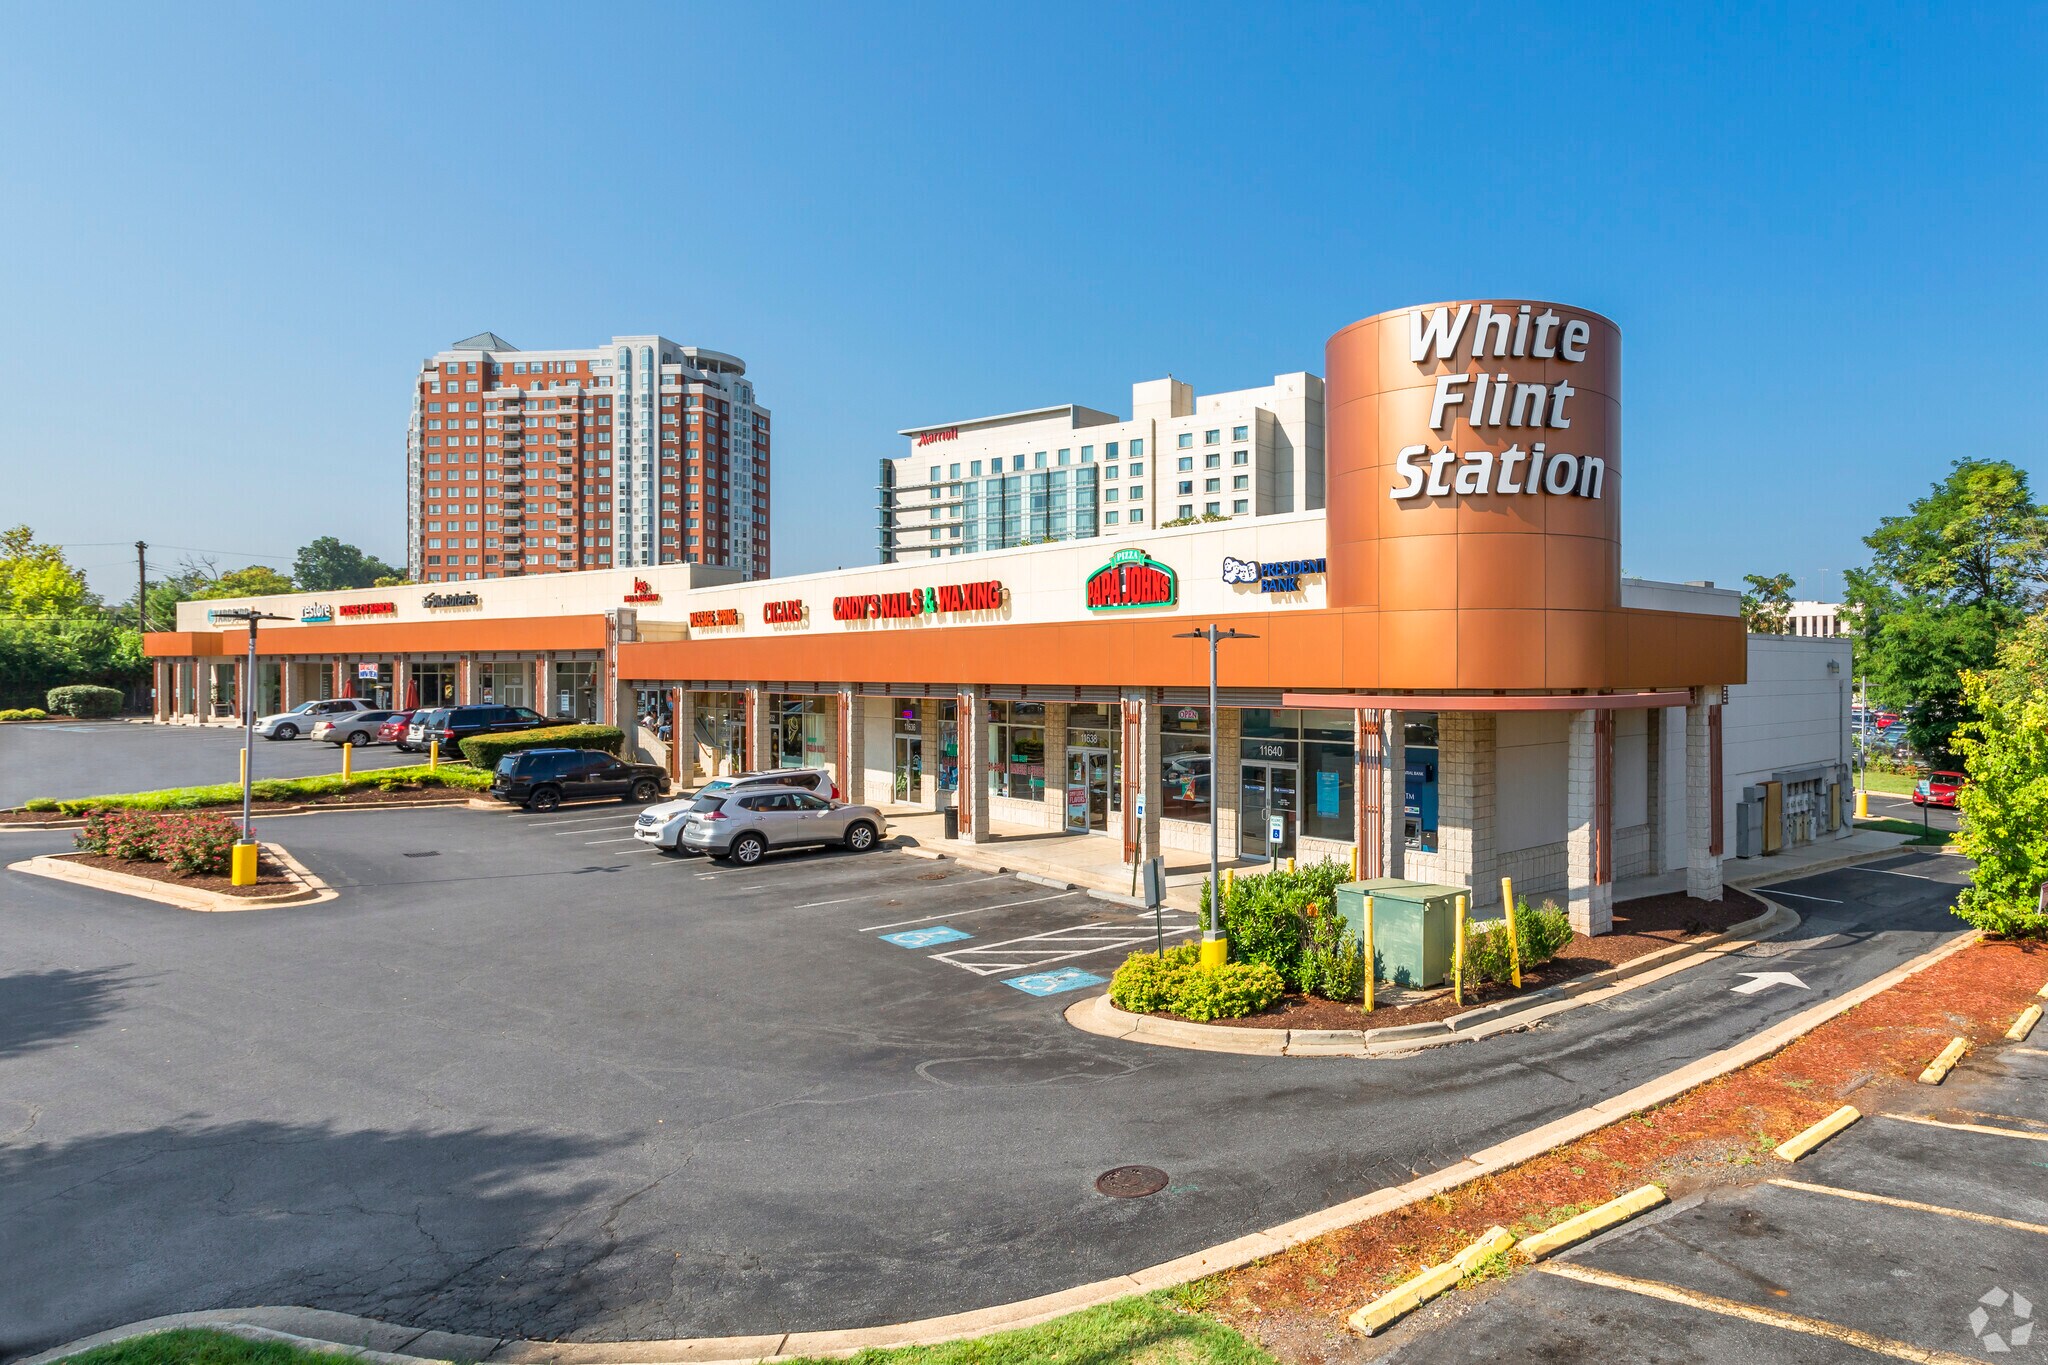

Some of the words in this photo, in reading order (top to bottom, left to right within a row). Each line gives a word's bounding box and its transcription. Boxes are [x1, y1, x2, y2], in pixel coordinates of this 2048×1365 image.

[1409, 304, 1590, 362] White
[1429, 374, 1575, 429] Flint
[917, 427, 958, 447] Marriott
[1389, 443, 1605, 500] Station
[1117, 551, 1138, 561] PIZZA
[1261, 558, 1326, 577] PRESIDENT
[1088, 568, 1121, 606] PAPA
[1261, 577, 1298, 593] BANK
[833, 594, 881, 620] CINDY'S
[881, 588, 923, 618] NAILS
[924, 587, 938, 614] &
[938, 580, 1002, 613] WAXING
[302, 602, 331, 618] restore
[340, 605, 360, 616] HOUSE
[361, 604, 370, 615] OF
[690, 611, 716, 628] MASSAGE
[716, 608, 738, 626] SPRING
[763, 599, 802, 624] CIGARS
[1179, 710, 1197, 719] OPEN
[1081, 734, 1098, 744] 11638
[1259, 745, 1283, 757] 11640
[1405, 792, 1415, 800] TM
